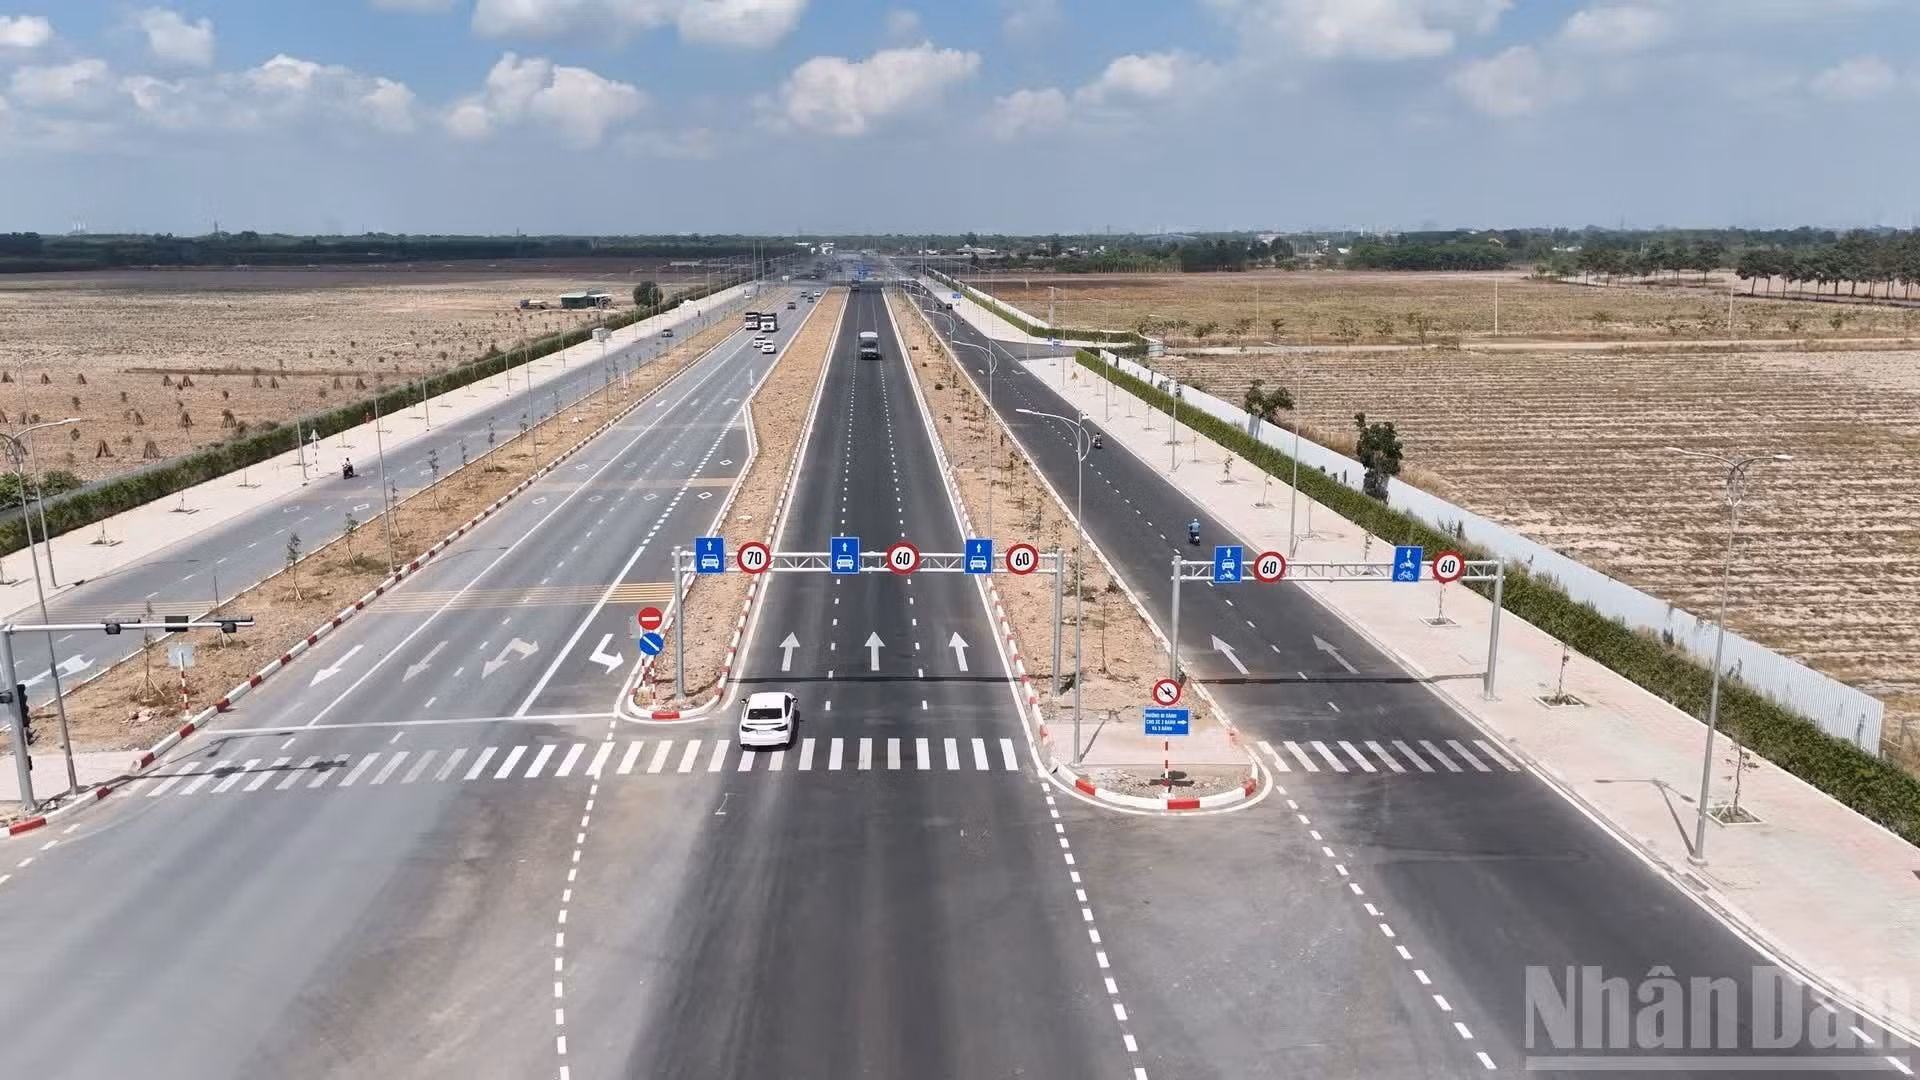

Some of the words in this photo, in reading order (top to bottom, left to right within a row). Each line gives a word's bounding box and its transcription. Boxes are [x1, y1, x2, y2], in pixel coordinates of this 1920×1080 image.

[747, 551, 762, 565] 70
[895, 551, 911, 566] 60
[1015, 552, 1030, 567] 60
[1262, 560, 1277, 575] 60
[1440, 559, 1456, 574] 60
